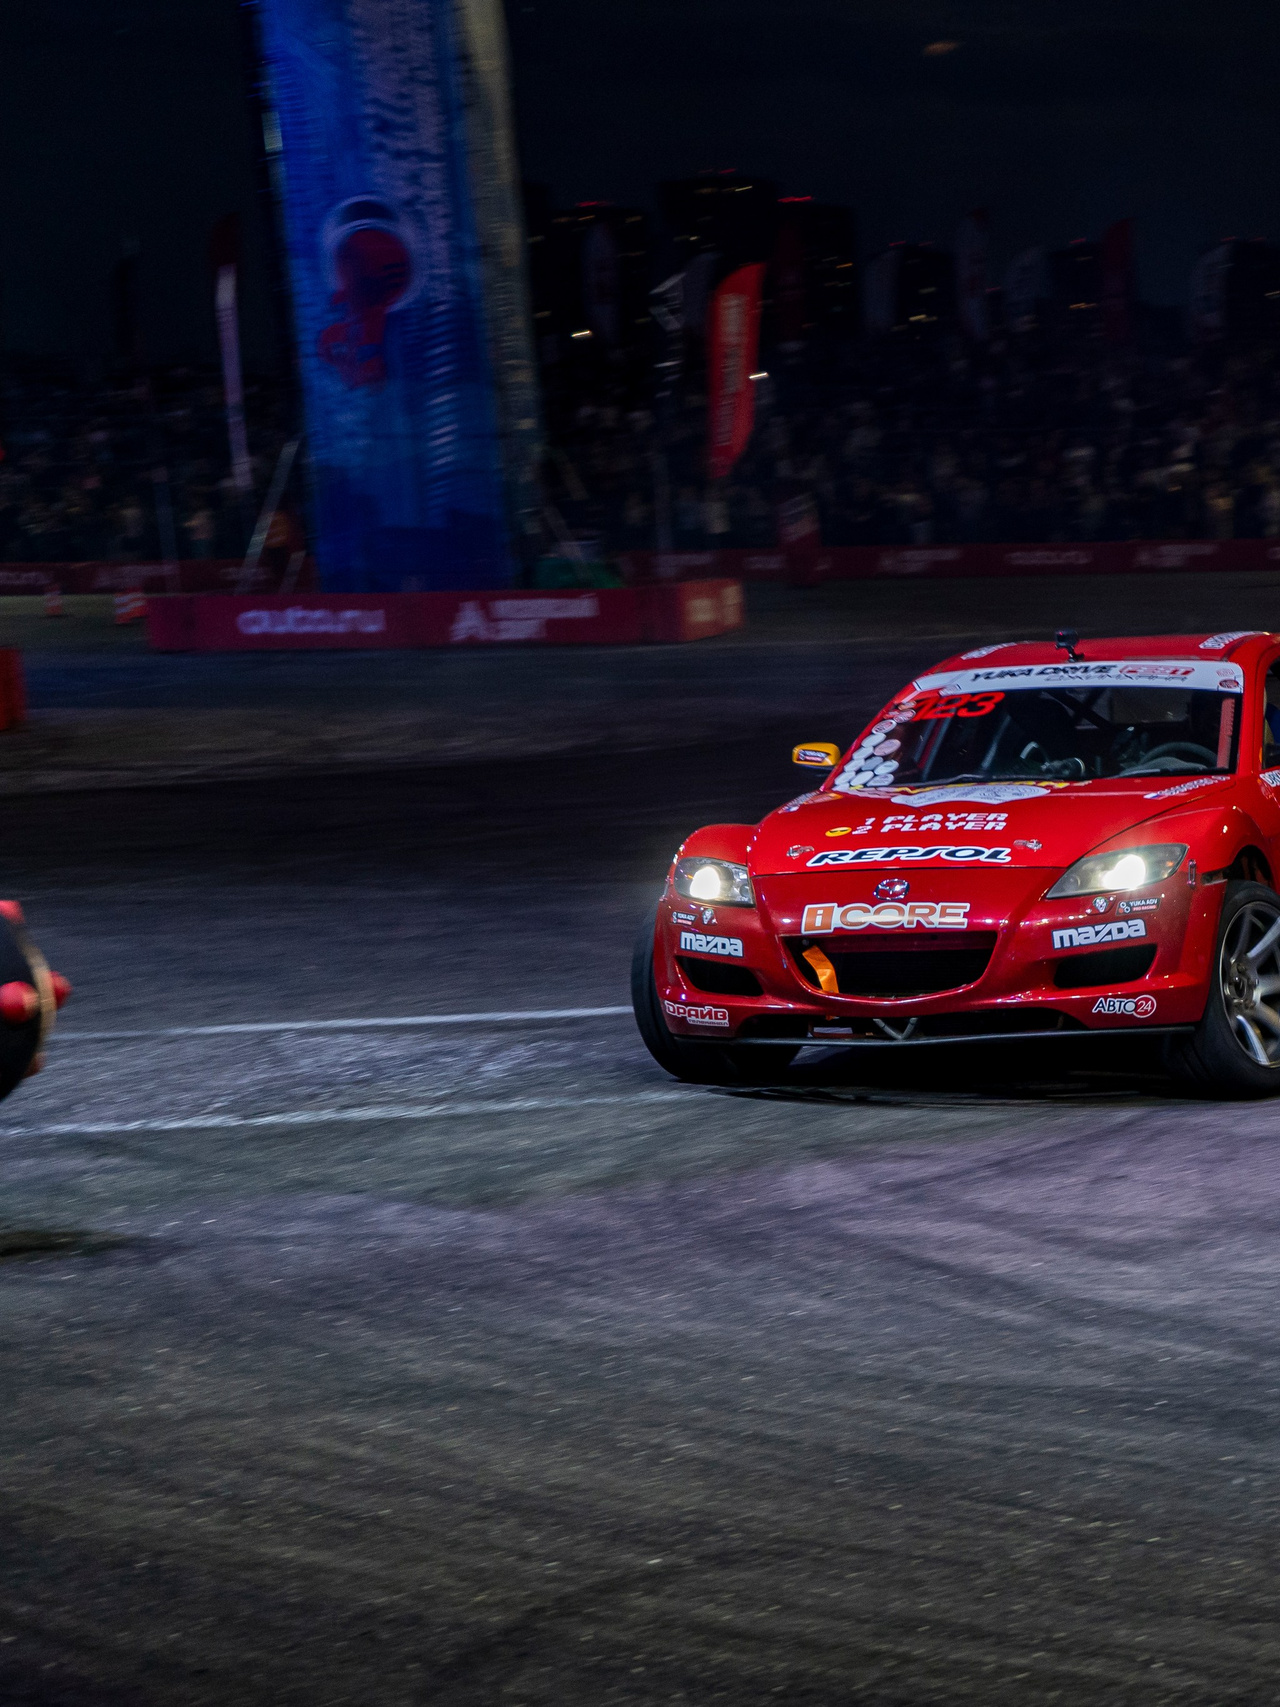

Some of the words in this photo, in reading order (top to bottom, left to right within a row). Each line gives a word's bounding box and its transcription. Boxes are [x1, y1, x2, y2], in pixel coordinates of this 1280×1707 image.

[852, 825, 873, 835] 2
[880, 821, 1007, 833] PLAYER
[865, 817, 876, 825] 1
[883, 812, 1009, 824] PLAYER
[808, 847, 1011, 866] REPSOL
[1053, 918, 1147, 949] mazda
[681, 931, 743, 957] mazda
